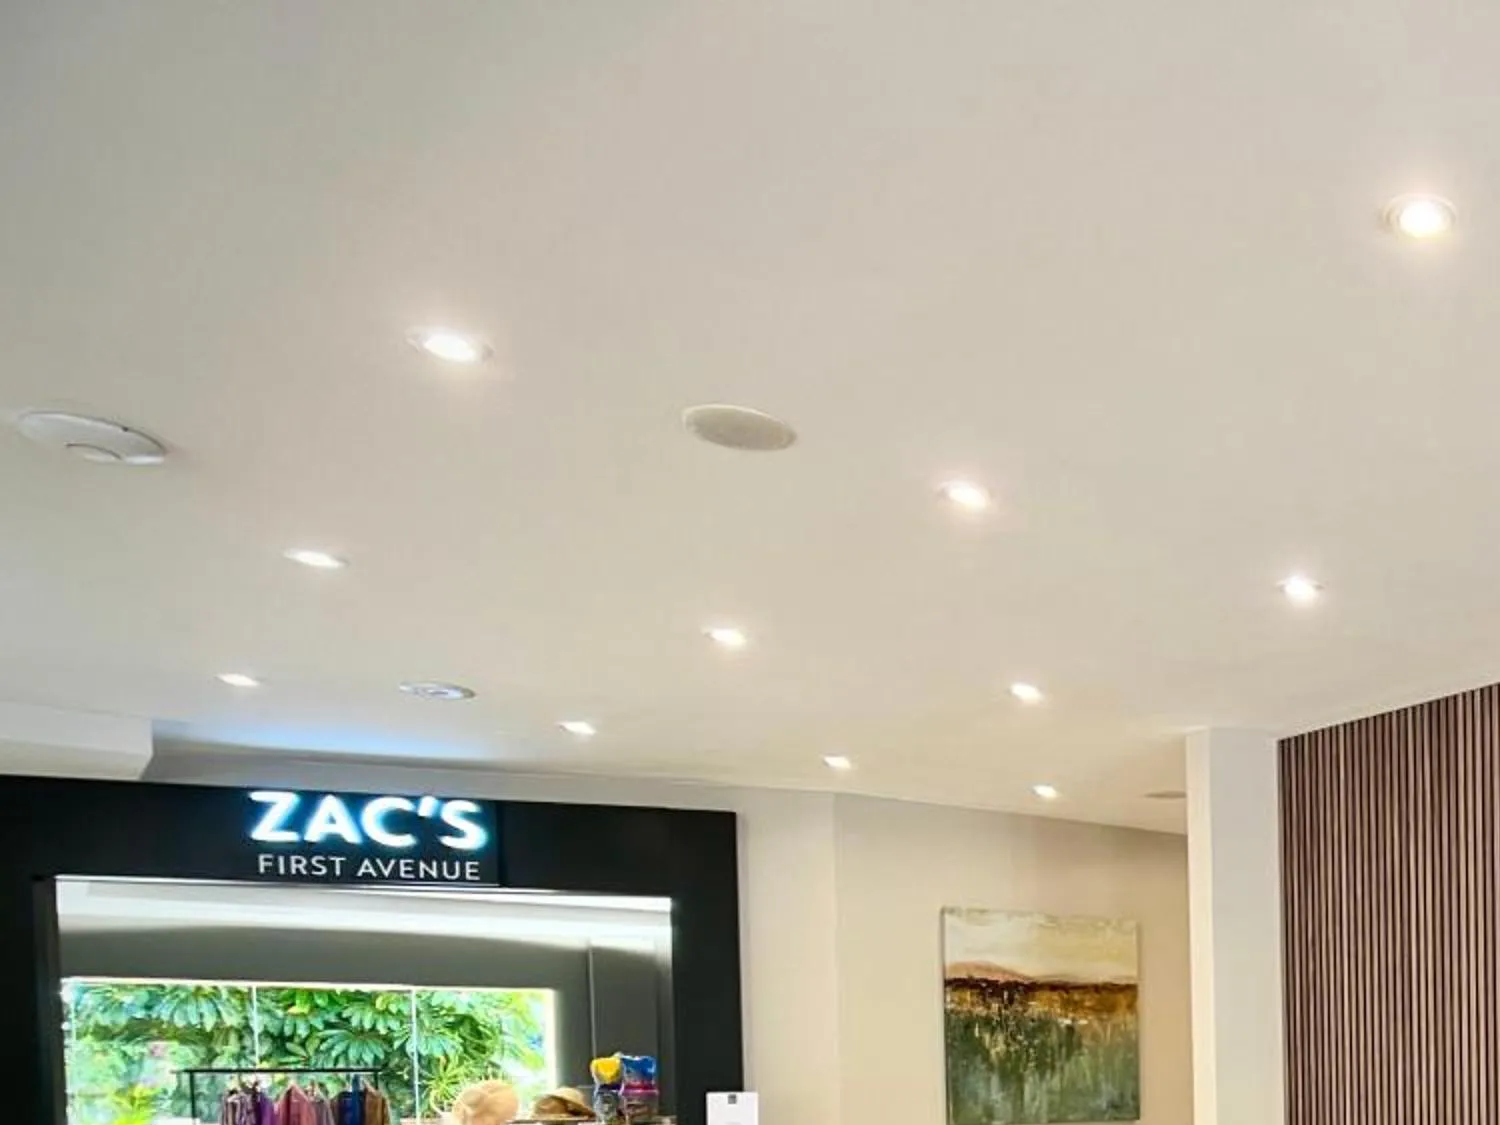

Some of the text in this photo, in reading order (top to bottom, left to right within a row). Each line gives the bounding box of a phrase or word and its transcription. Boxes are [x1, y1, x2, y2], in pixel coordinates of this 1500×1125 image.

[249, 791, 488, 850] ZAC'S
[258, 854, 481, 881] FIRST AVENUE
